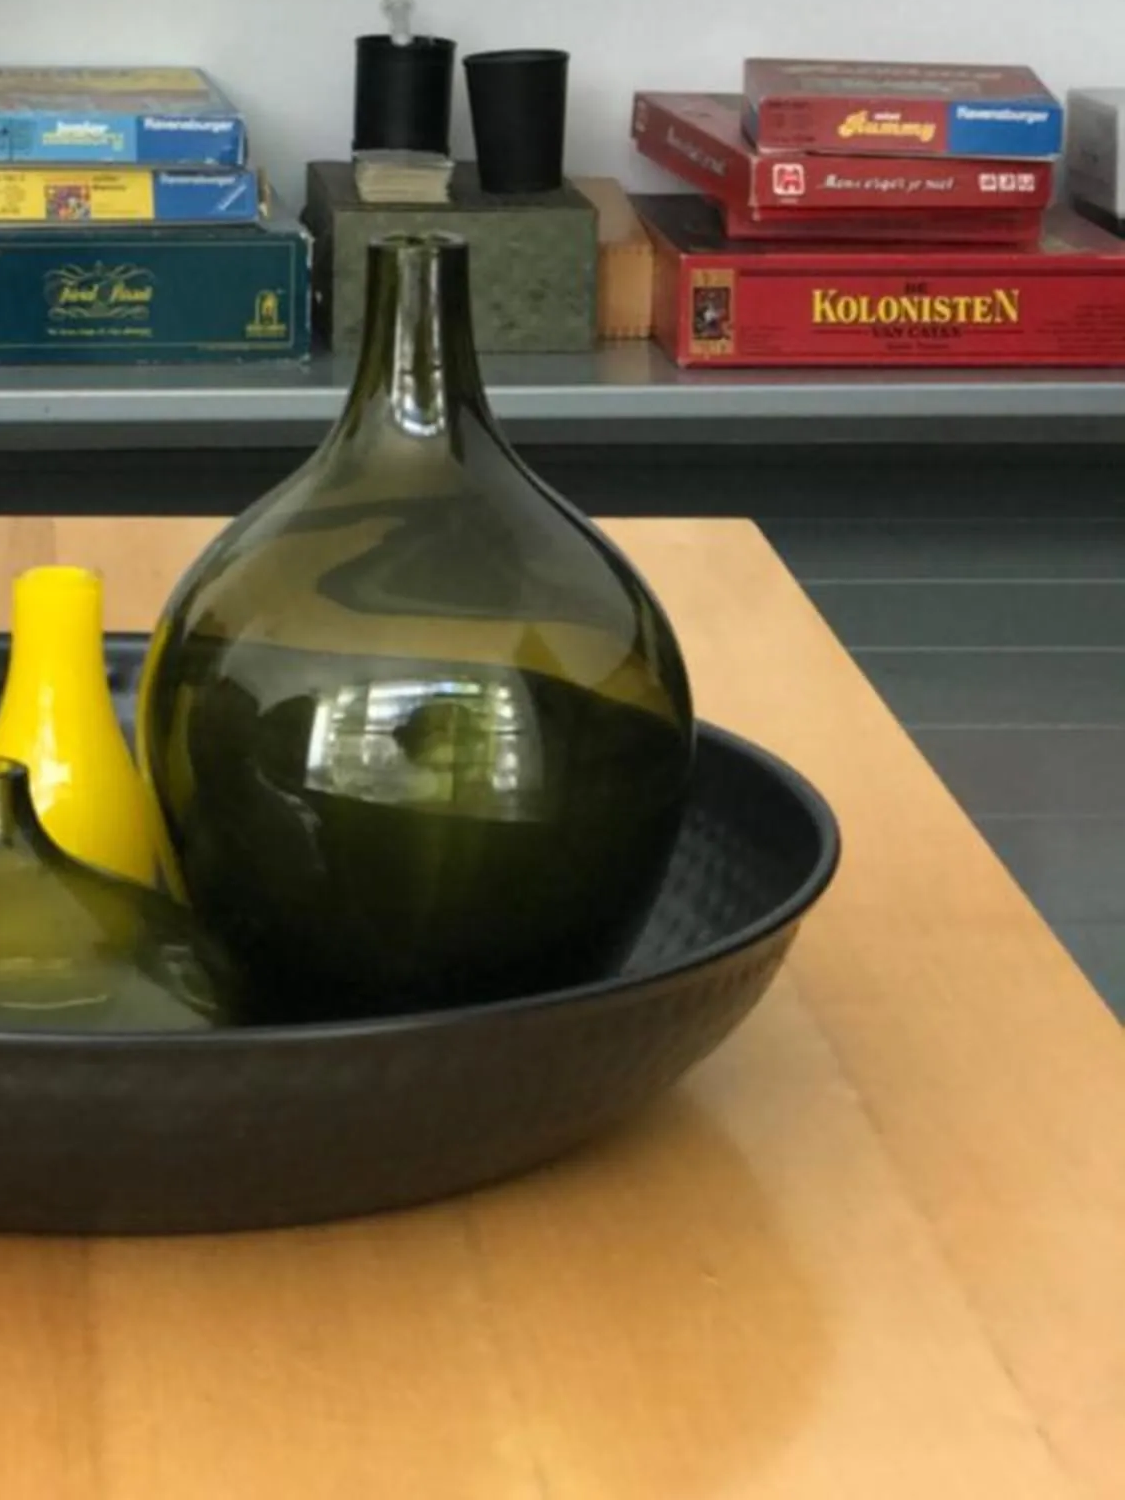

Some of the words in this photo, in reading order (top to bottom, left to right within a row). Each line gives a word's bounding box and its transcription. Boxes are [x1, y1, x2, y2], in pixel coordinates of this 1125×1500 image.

[956, 106, 1049, 125] Ravensburger
[144, 118, 234, 133] Ravensburger
[812, 288, 1020, 324] KOLONISTEN
